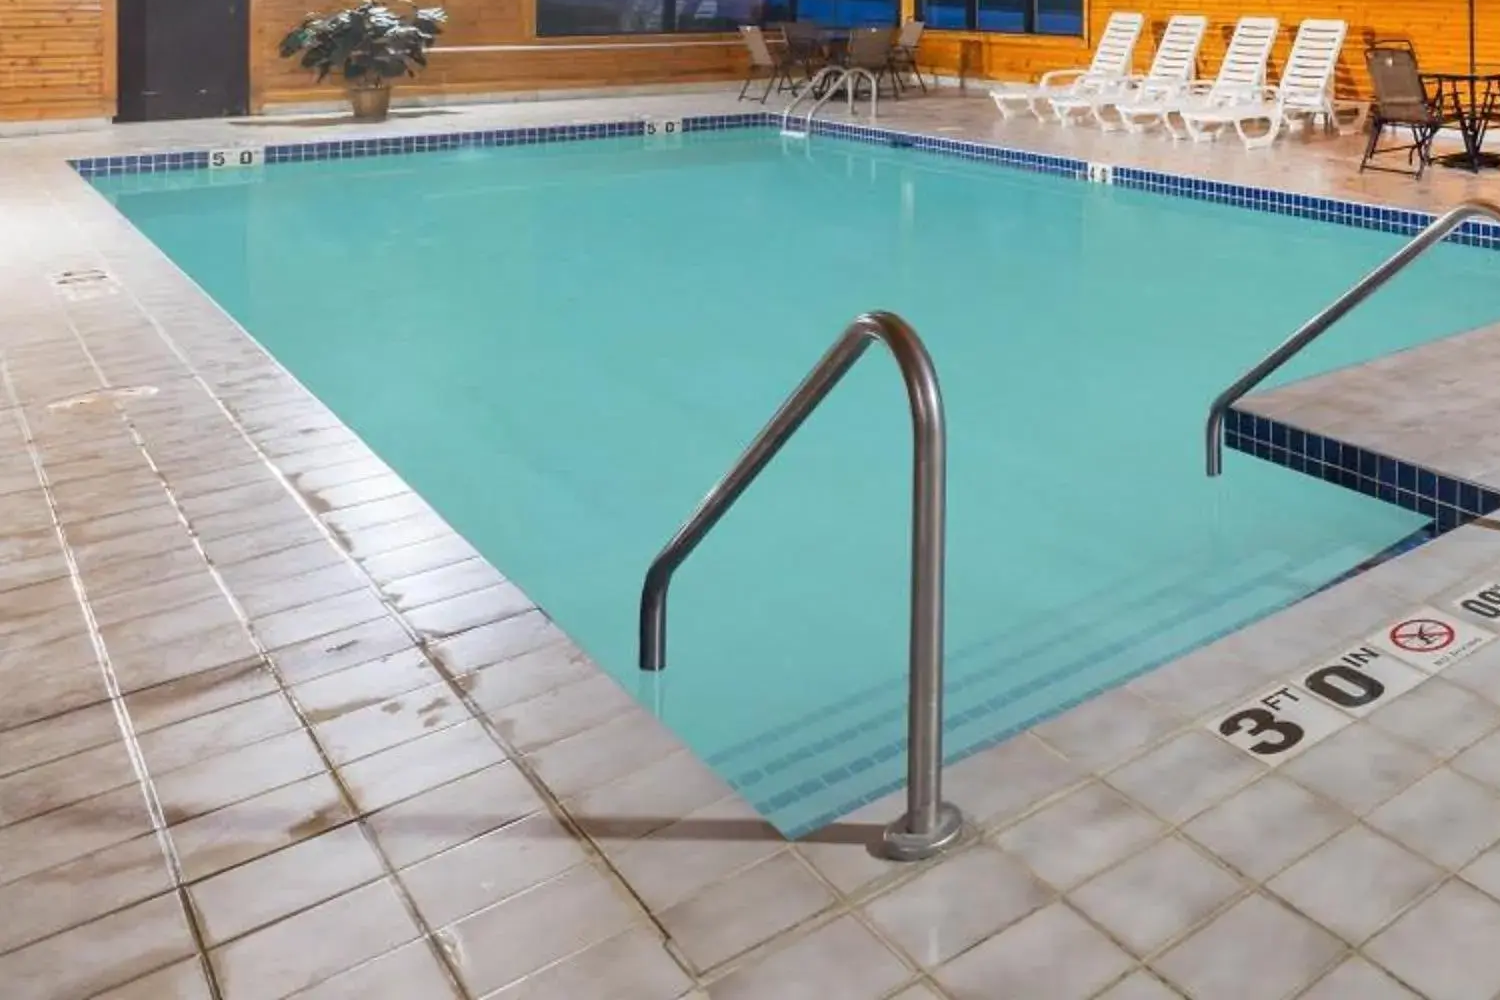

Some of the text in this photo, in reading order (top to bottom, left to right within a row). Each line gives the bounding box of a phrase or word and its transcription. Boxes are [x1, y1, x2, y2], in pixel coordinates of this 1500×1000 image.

[212, 151, 253, 167] 5 0
[1219, 647, 1385, 755] 3 FT 0 IN
